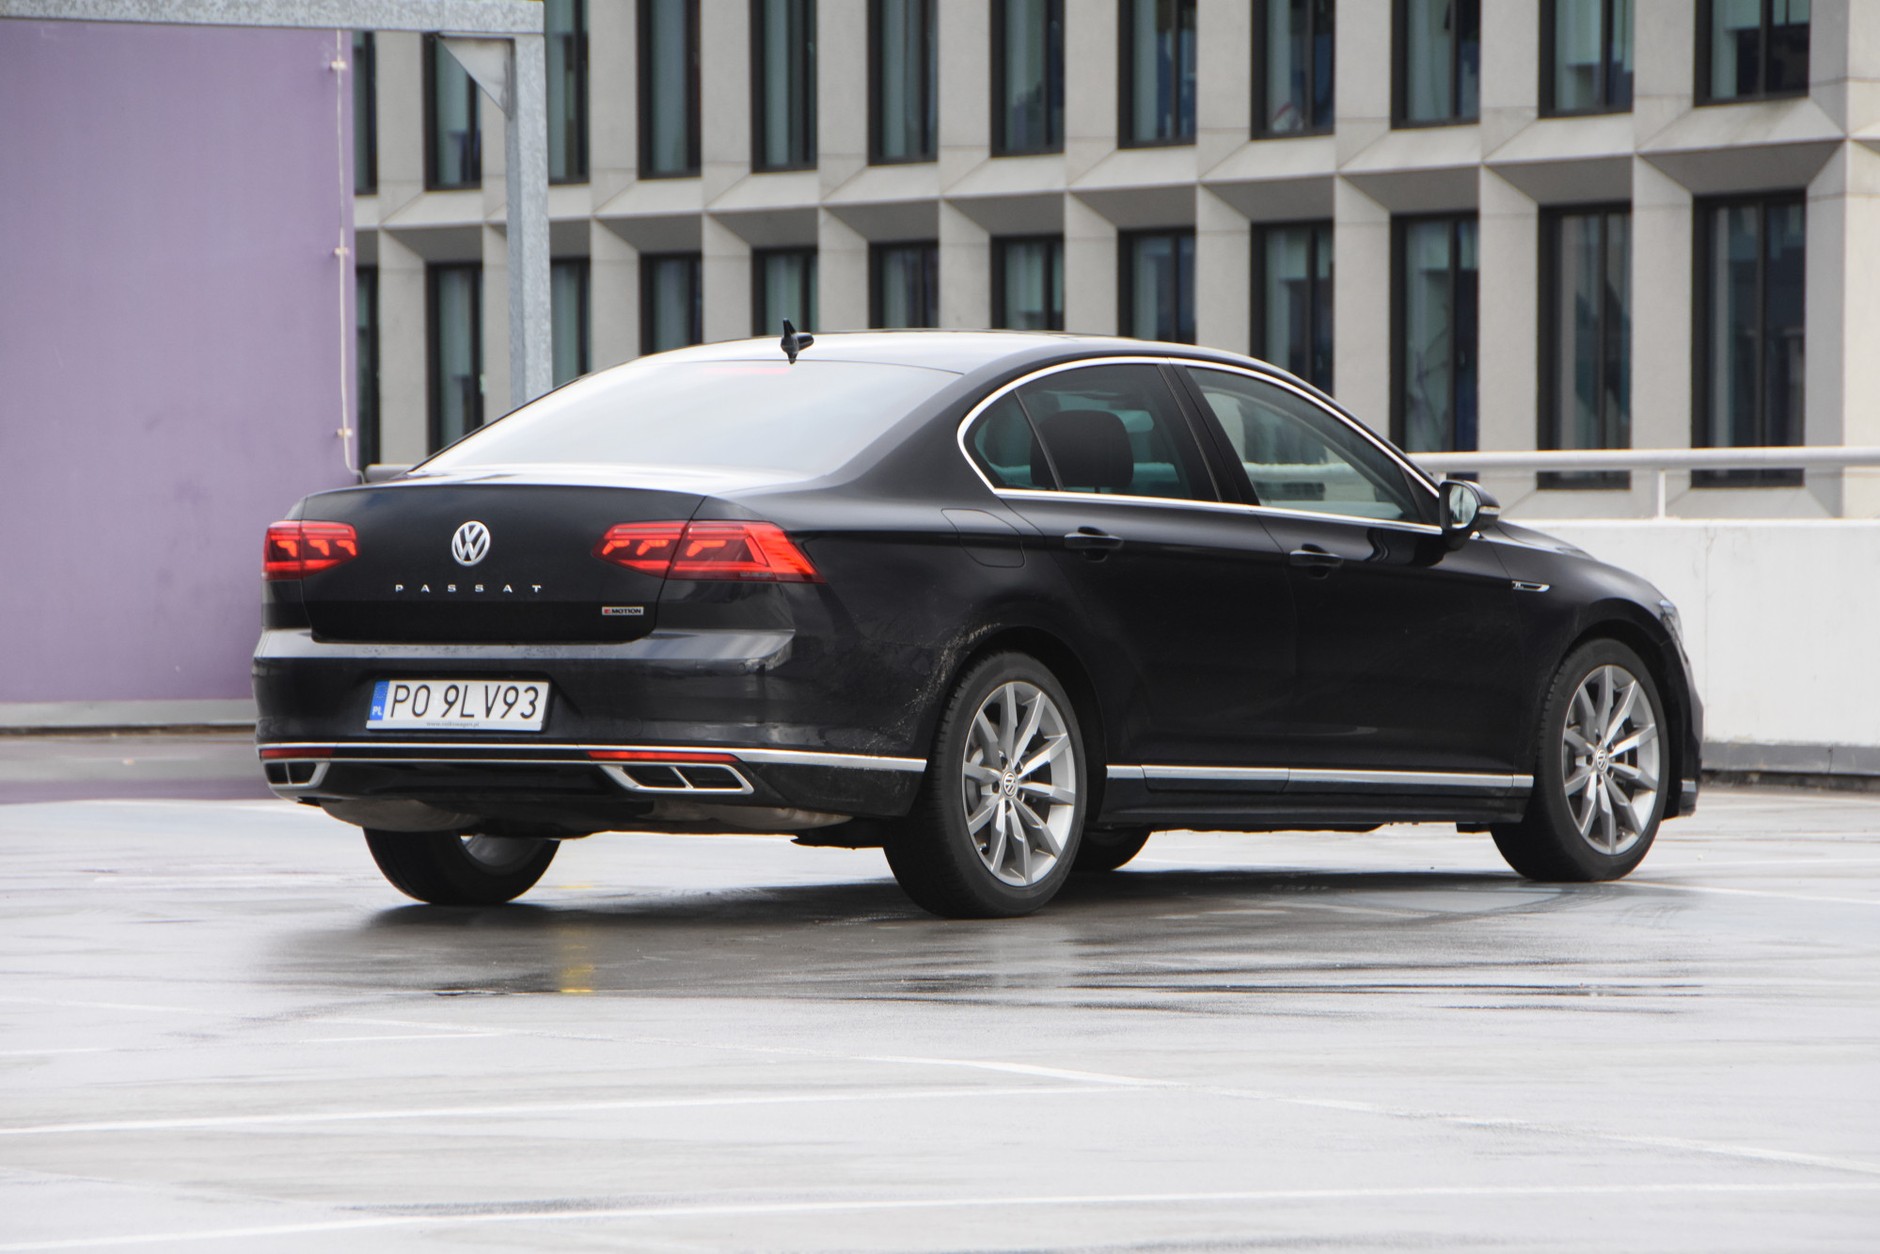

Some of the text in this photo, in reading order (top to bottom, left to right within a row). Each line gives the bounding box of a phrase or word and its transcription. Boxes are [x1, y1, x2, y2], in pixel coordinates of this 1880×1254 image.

[452, 520, 491, 567] VW
[395, 584, 542, 593] PASSAT
[372, 705, 383, 716] PL
[441, 684, 539, 719] 9LV93
